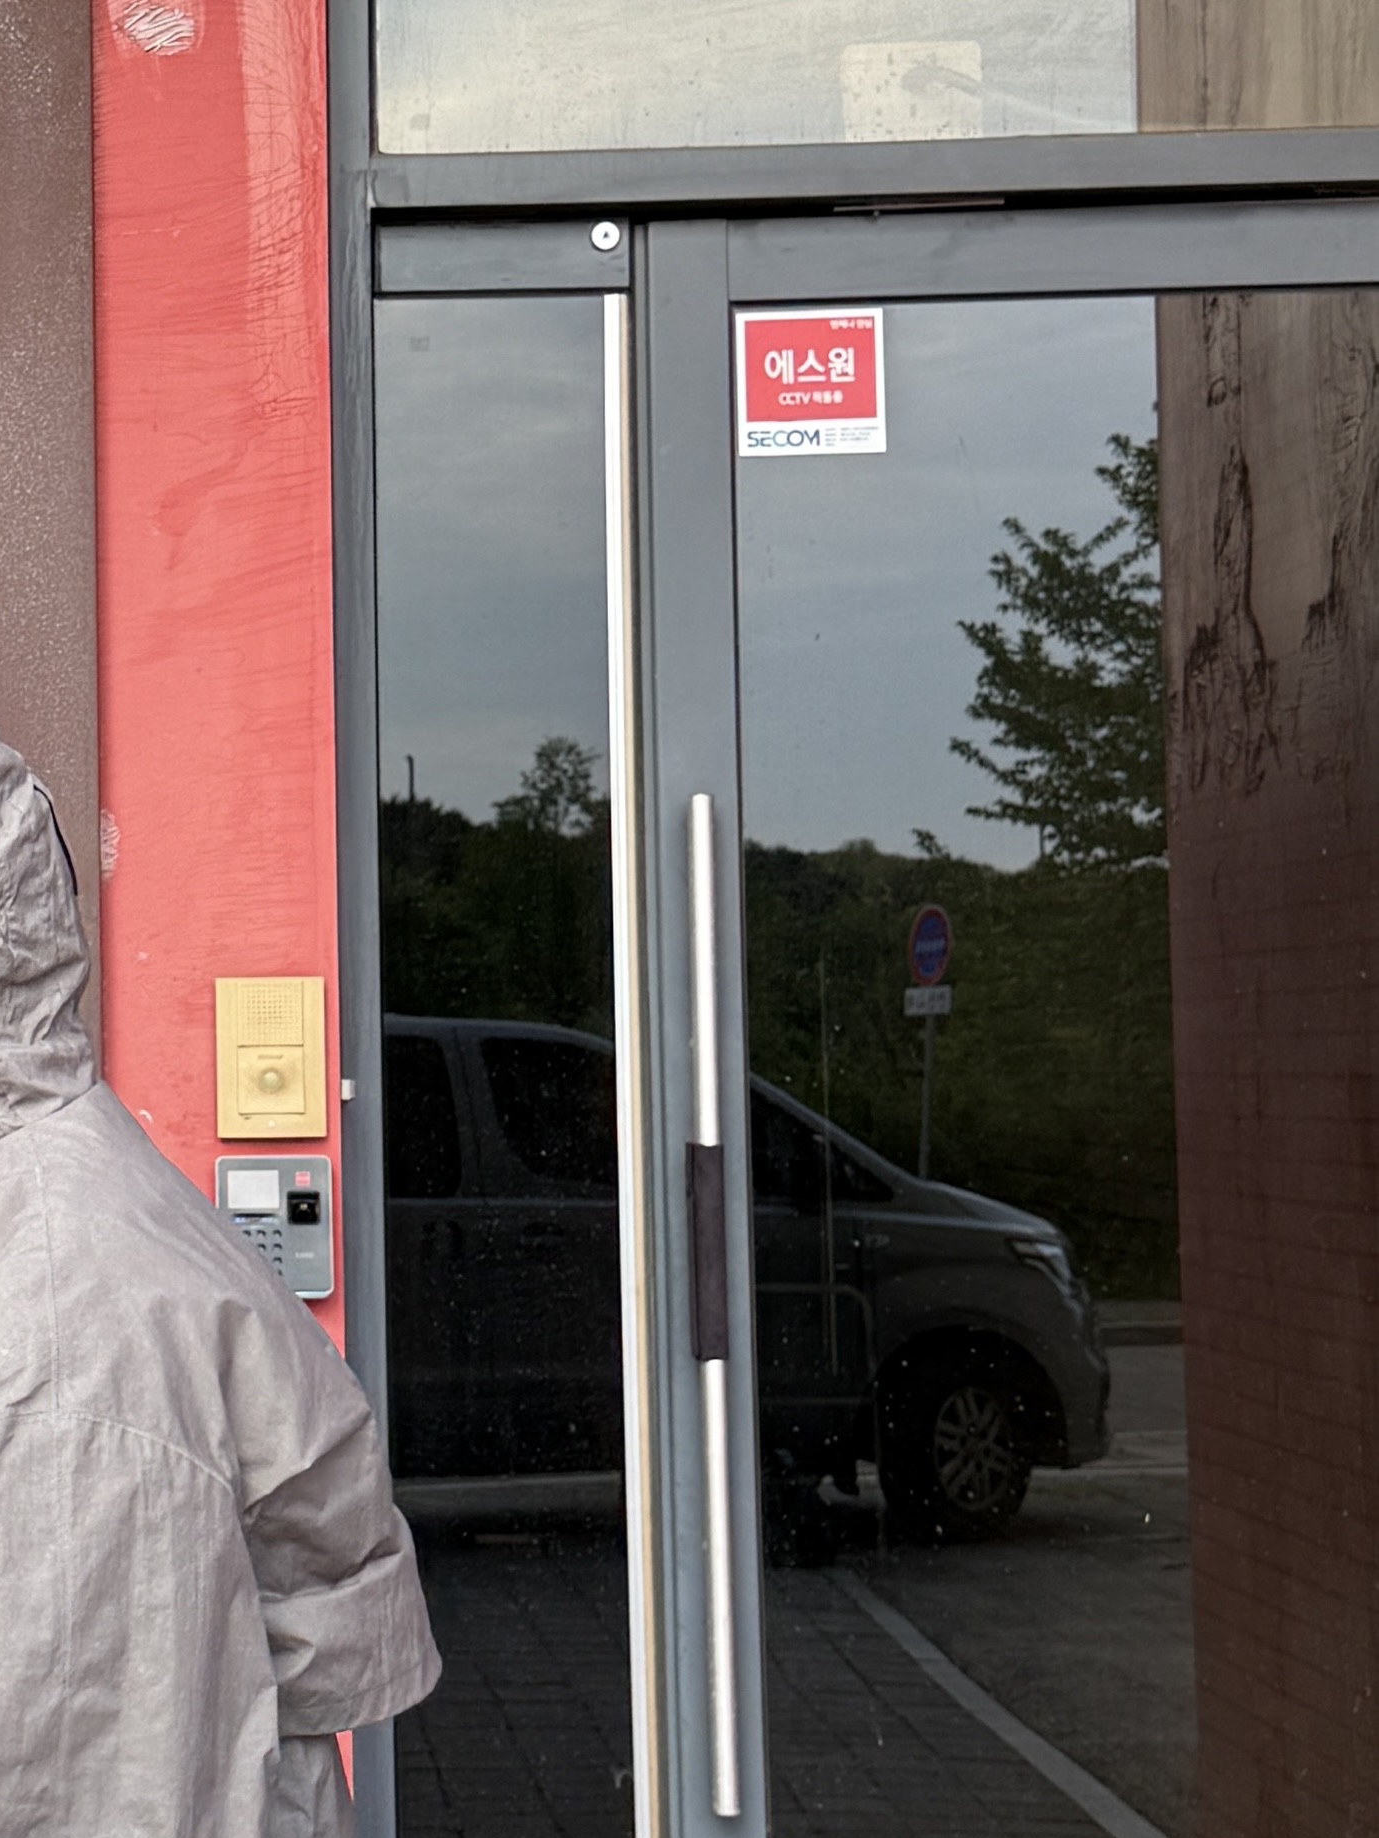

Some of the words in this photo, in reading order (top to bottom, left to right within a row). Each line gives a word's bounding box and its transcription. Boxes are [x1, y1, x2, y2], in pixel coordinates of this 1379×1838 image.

[764, 347, 855, 385] 에스원
[778, 393, 811, 406] CCTV
[747, 429, 820, 448] SECOM
